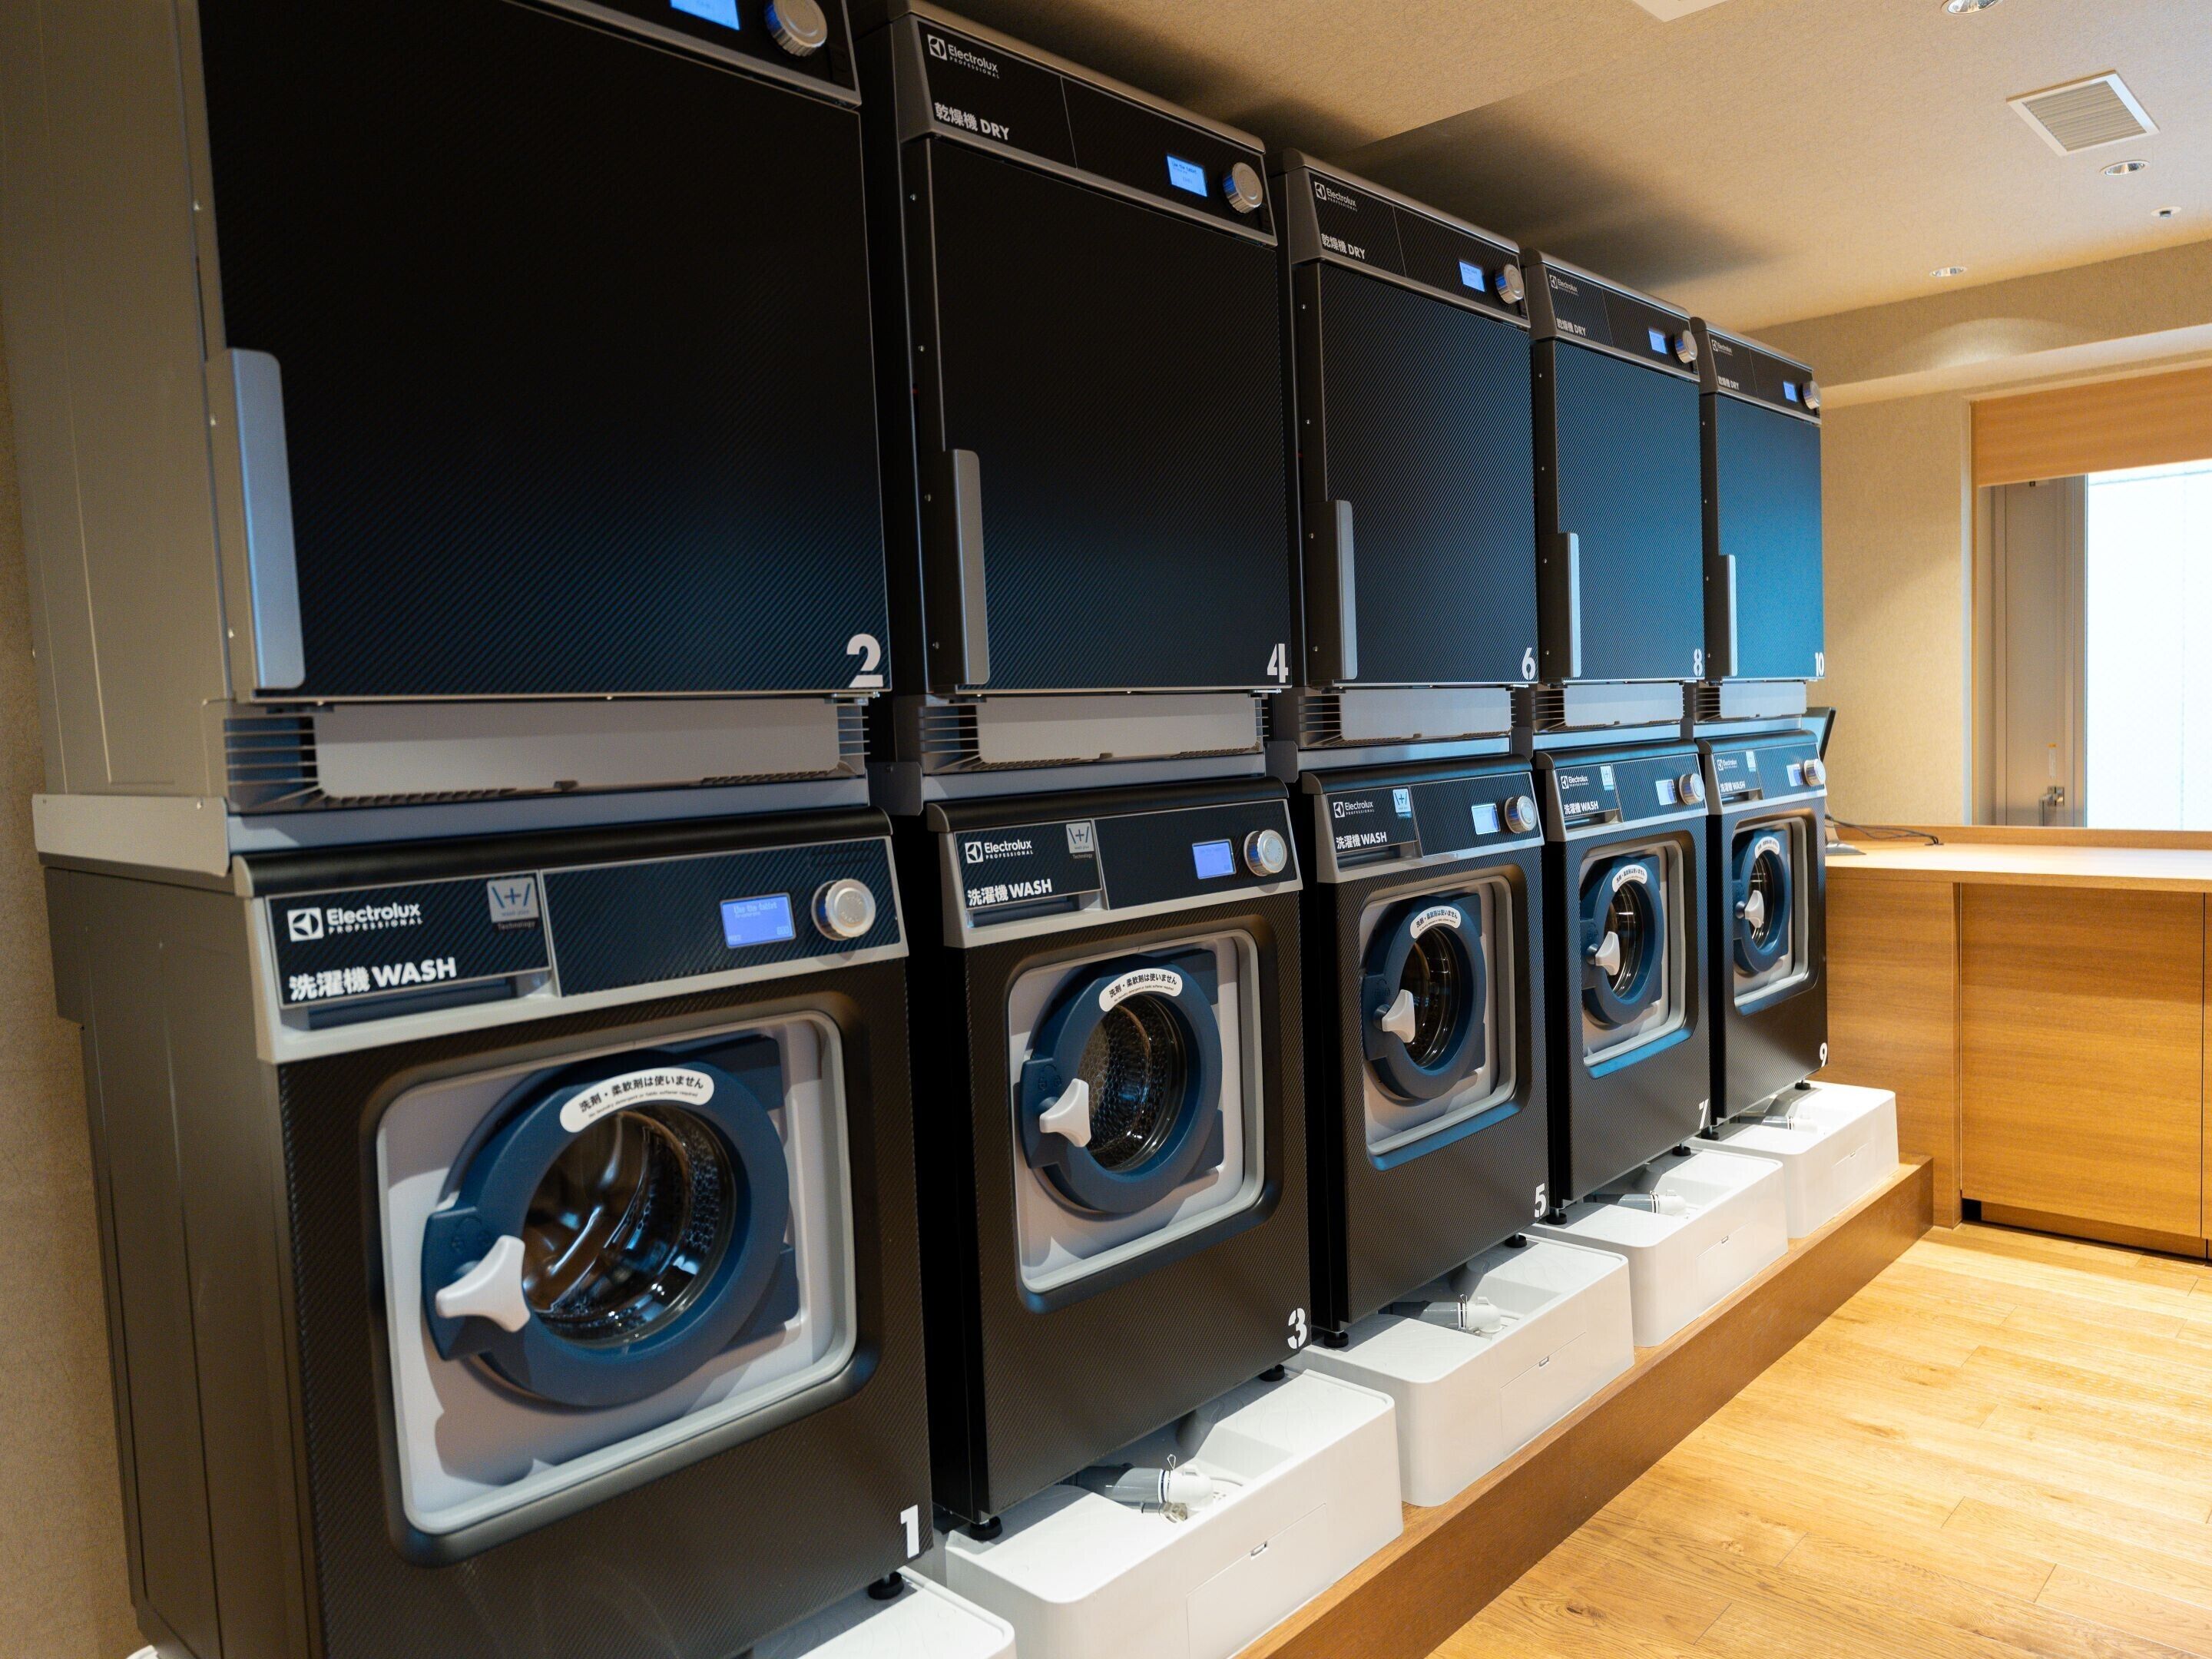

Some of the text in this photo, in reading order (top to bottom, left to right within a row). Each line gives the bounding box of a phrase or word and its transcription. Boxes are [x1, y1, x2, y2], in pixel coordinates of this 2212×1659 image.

[947, 44, 998, 73] Electrolux
[949, 56, 1000, 79] PROFESSIONAL
[934, 101, 1010, 141] 乾燥機 DRY
[1326, 187, 1357, 207] Electrolux
[1347, 243, 1366, 260] DRY
[1574, 323, 1586, 336] DRY
[846, 633, 884, 688] 2
[1267, 643, 1289, 684] 4
[1522, 647, 1536, 680] 6
[1693, 648, 1703, 677] 8
[1815, 651, 1825, 677] 10
[1344, 800, 1374, 811] Electrolux
[1580, 800, 1599, 812] WASH
[984, 839, 1032, 854] Electrolux
[1336, 831, 1388, 849] 洗濯機 WASH
[985, 849, 1034, 859] PROFESSIONAL
[967, 878, 1053, 906] 洗濯機 WASH
[326, 902, 422, 926] Electrolux
[327, 917, 423, 935] PROFESSIONAL
[289, 956, 457, 1002] 洗濯機 WASH
[1819, 1041, 1828, 1068] 9
[579, 1075, 704, 1114] 洗剤・柔軟剤は使いません
[1698, 1098, 1710, 1130] 7
[1534, 1182, 1547, 1218] 5
[1287, 1307, 1307, 1349] 3
[900, 1504, 920, 1559] 1
